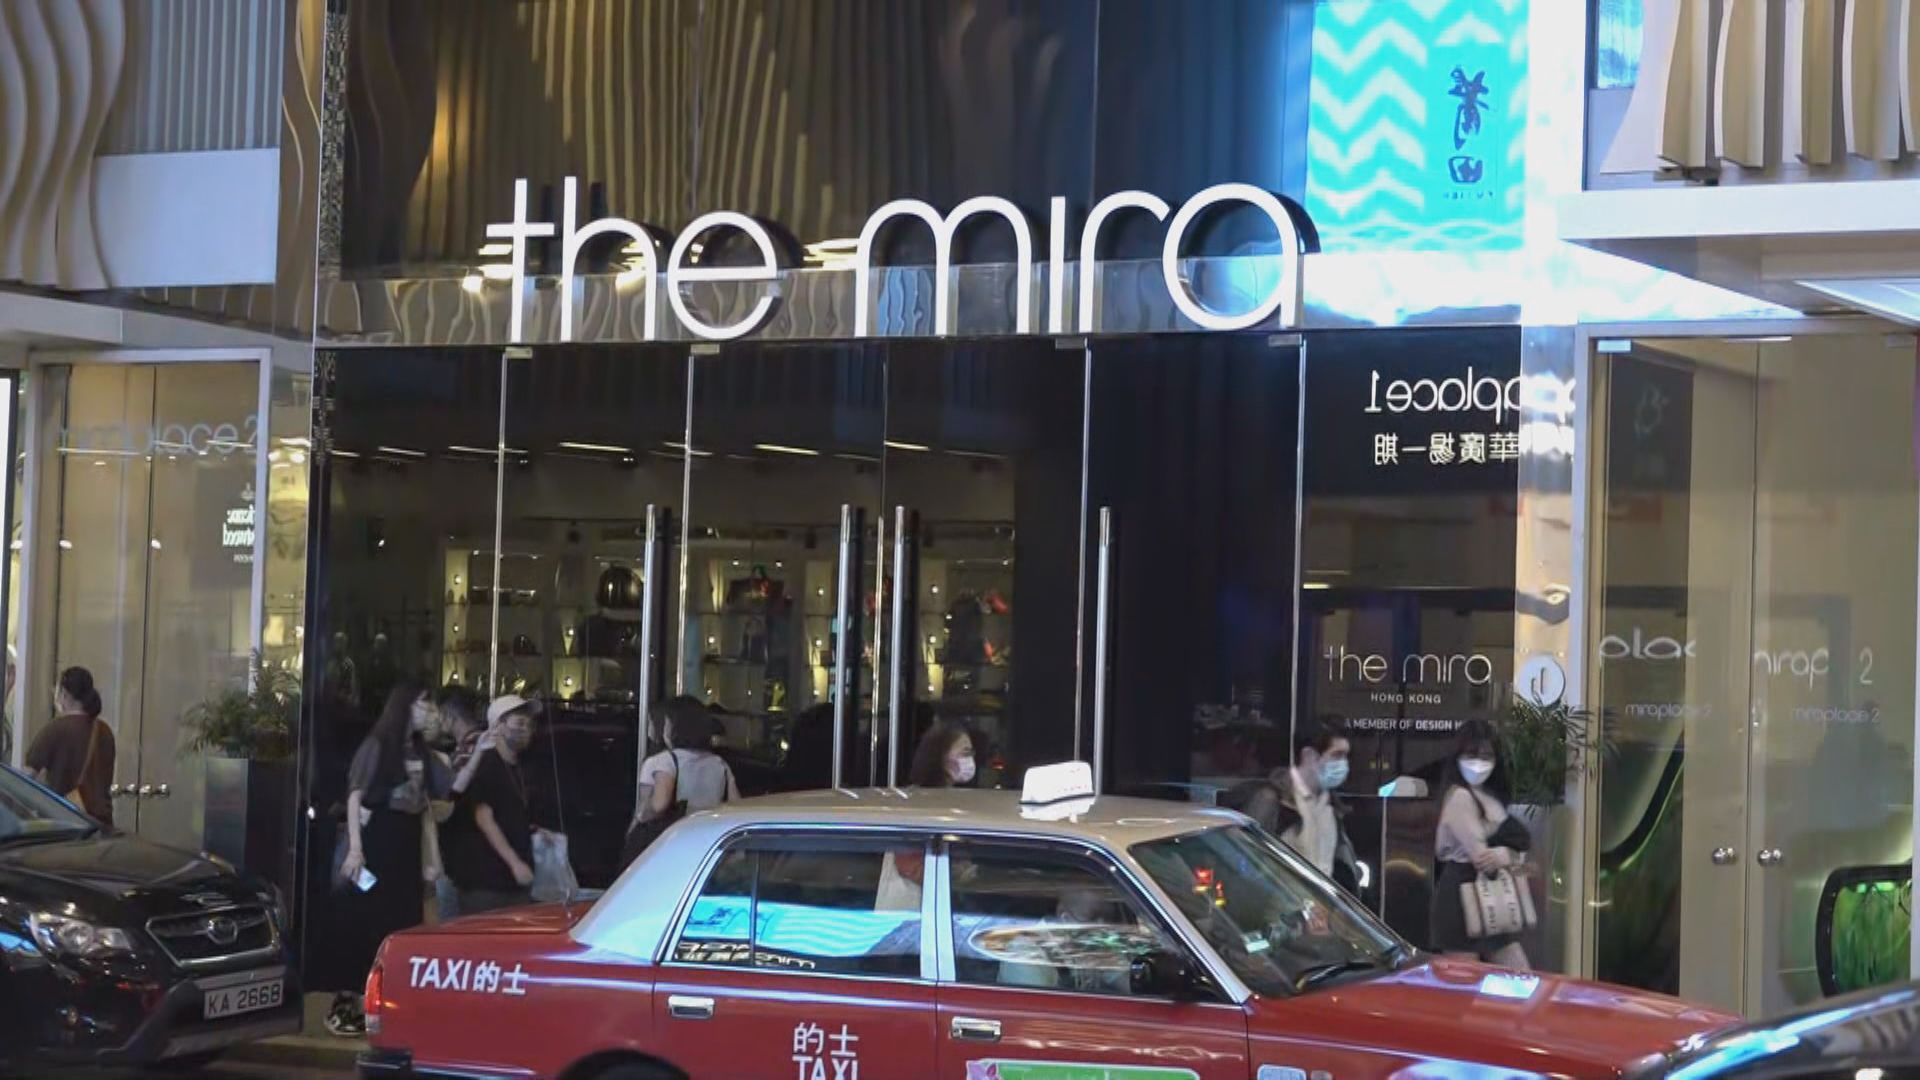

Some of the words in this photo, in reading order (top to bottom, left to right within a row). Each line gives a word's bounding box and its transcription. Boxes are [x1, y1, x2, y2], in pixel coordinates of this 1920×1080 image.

[486, 176, 783, 342] the
[853, 182, 1304, 338] mira
[1323, 645, 1388, 682] the
[1402, 653, 1493, 684] mira
[1371, 691, 1404, 703] HONG
[1408, 693, 1442, 704] KONG
[1353, 718, 1397, 730] MEMBER
[1399, 719, 1412, 730] OF
[1415, 719, 1452, 731] DESIGN
[408, 956, 472, 991] TAXI
[472, 960, 529, 996] 的士
[208, 991, 230, 1015] KA
[793, 1022, 859, 1057] 的士
[792, 1055, 859, 1080] TAXI
